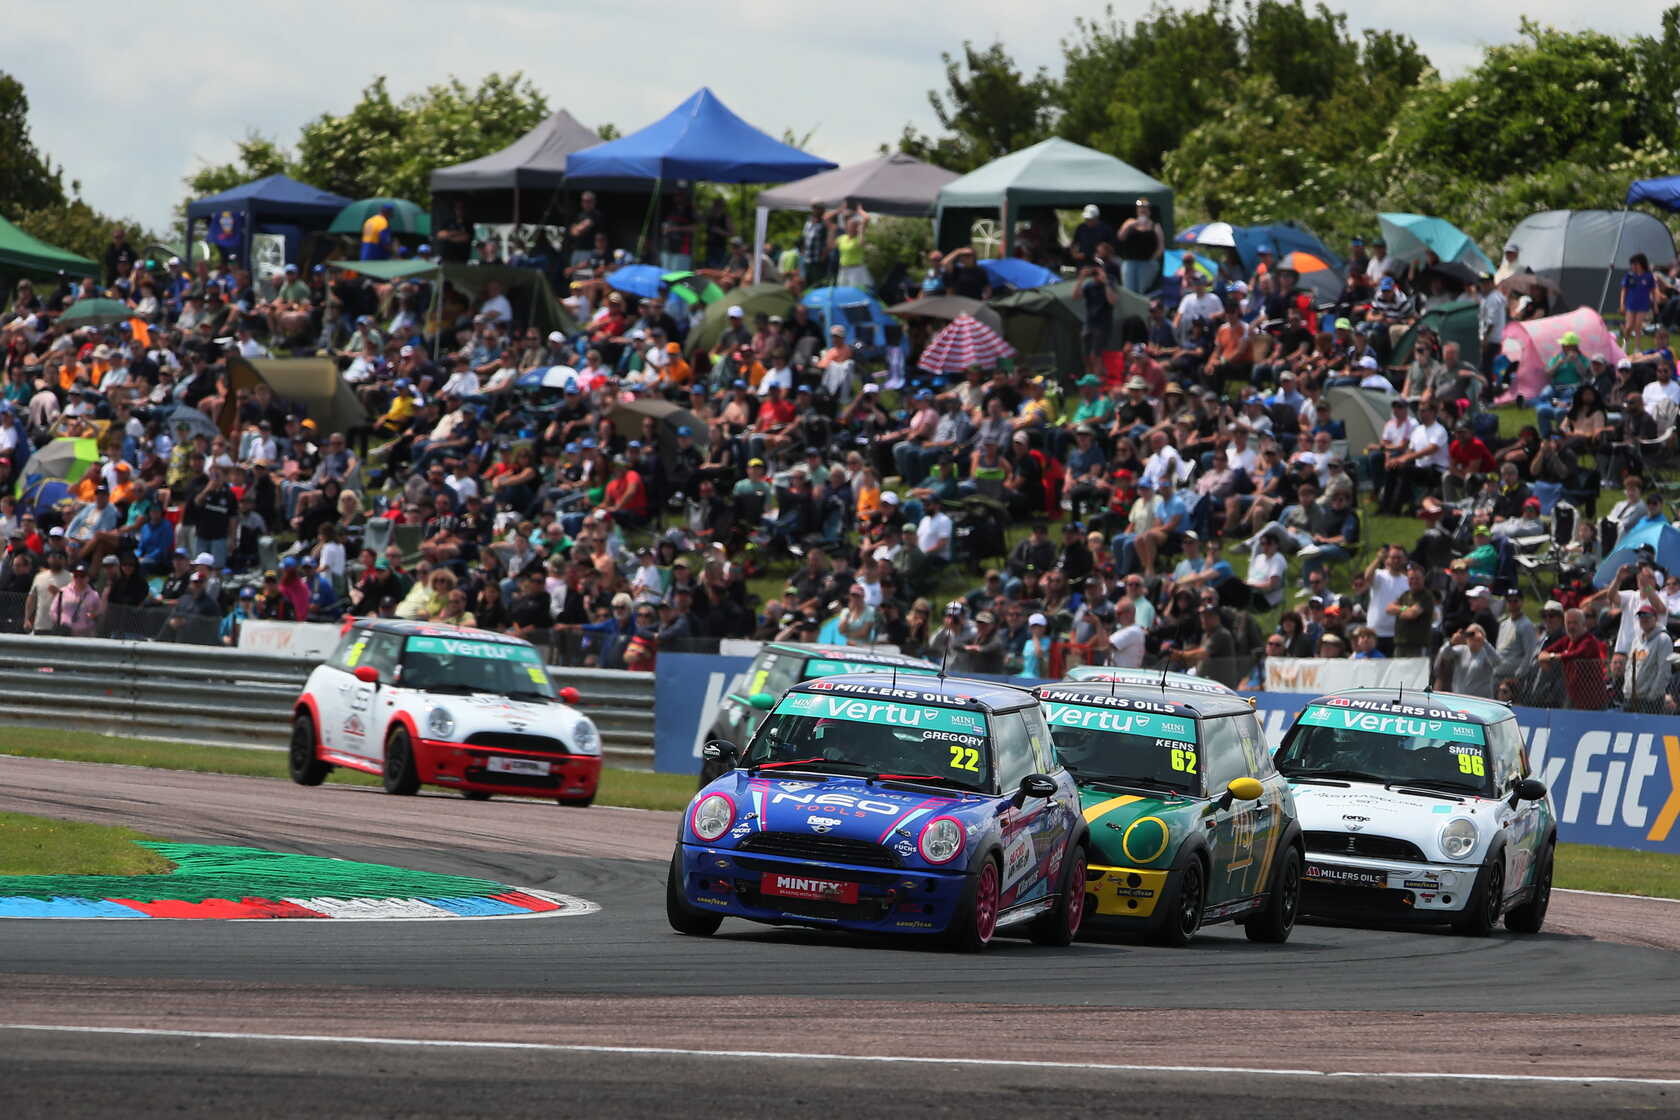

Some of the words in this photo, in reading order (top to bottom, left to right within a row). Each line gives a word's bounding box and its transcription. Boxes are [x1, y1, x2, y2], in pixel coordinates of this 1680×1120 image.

[441, 640, 508, 659] Vertu
[834, 683, 918, 699] MILLERS
[922, 693, 966, 706] OILS
[1050, 690, 1129, 707] MILLERS
[1134, 700, 1176, 713] OILS
[829, 698, 921, 726] Vertu
[951, 715, 975, 725] MINI
[1045, 704, 1133, 732] Vertu
[1351, 700, 1425, 716] MILLERS
[1429, 709, 1468, 721] OILS
[1161, 722, 1185, 732] MINI
[1343, 709, 1427, 736] Vertu
[1453, 727, 1475, 735] MINI
[922, 731, 984, 746] GREGORY
[1155, 739, 1195, 752] KEENS
[950, 745, 979, 772] 22
[1448, 745, 1482, 757] SMITH
[1171, 748, 1197, 774] 62
[1458, 753, 1485, 777] 96
[771, 793, 900, 815] NEO
[795, 804, 868, 818] TOOLS
[894, 843, 917, 853] FUCHS
[776, 876, 840, 894] MINTEX
[1320, 869, 1359, 881] MILLERS
[1360, 873, 1382, 883] OILS
